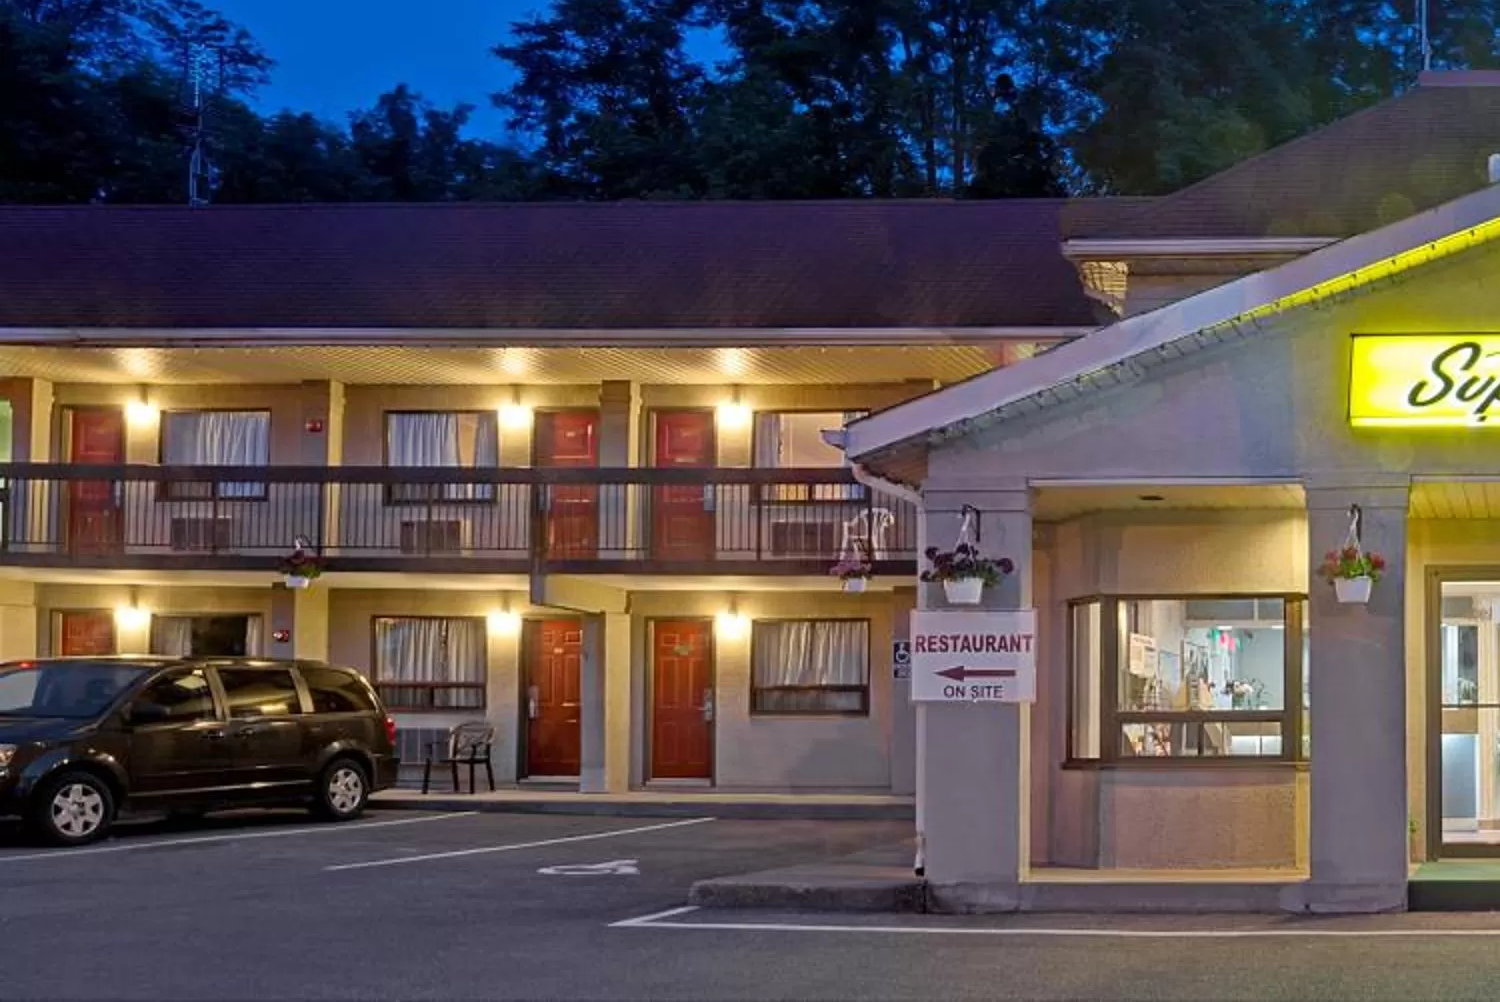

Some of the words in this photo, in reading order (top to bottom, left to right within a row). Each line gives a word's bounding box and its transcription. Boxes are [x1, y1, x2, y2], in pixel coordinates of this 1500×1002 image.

[915, 634, 1033, 653] RESTAURANT
[943, 685, 966, 698] ON
[971, 685, 1003, 699] SITE
